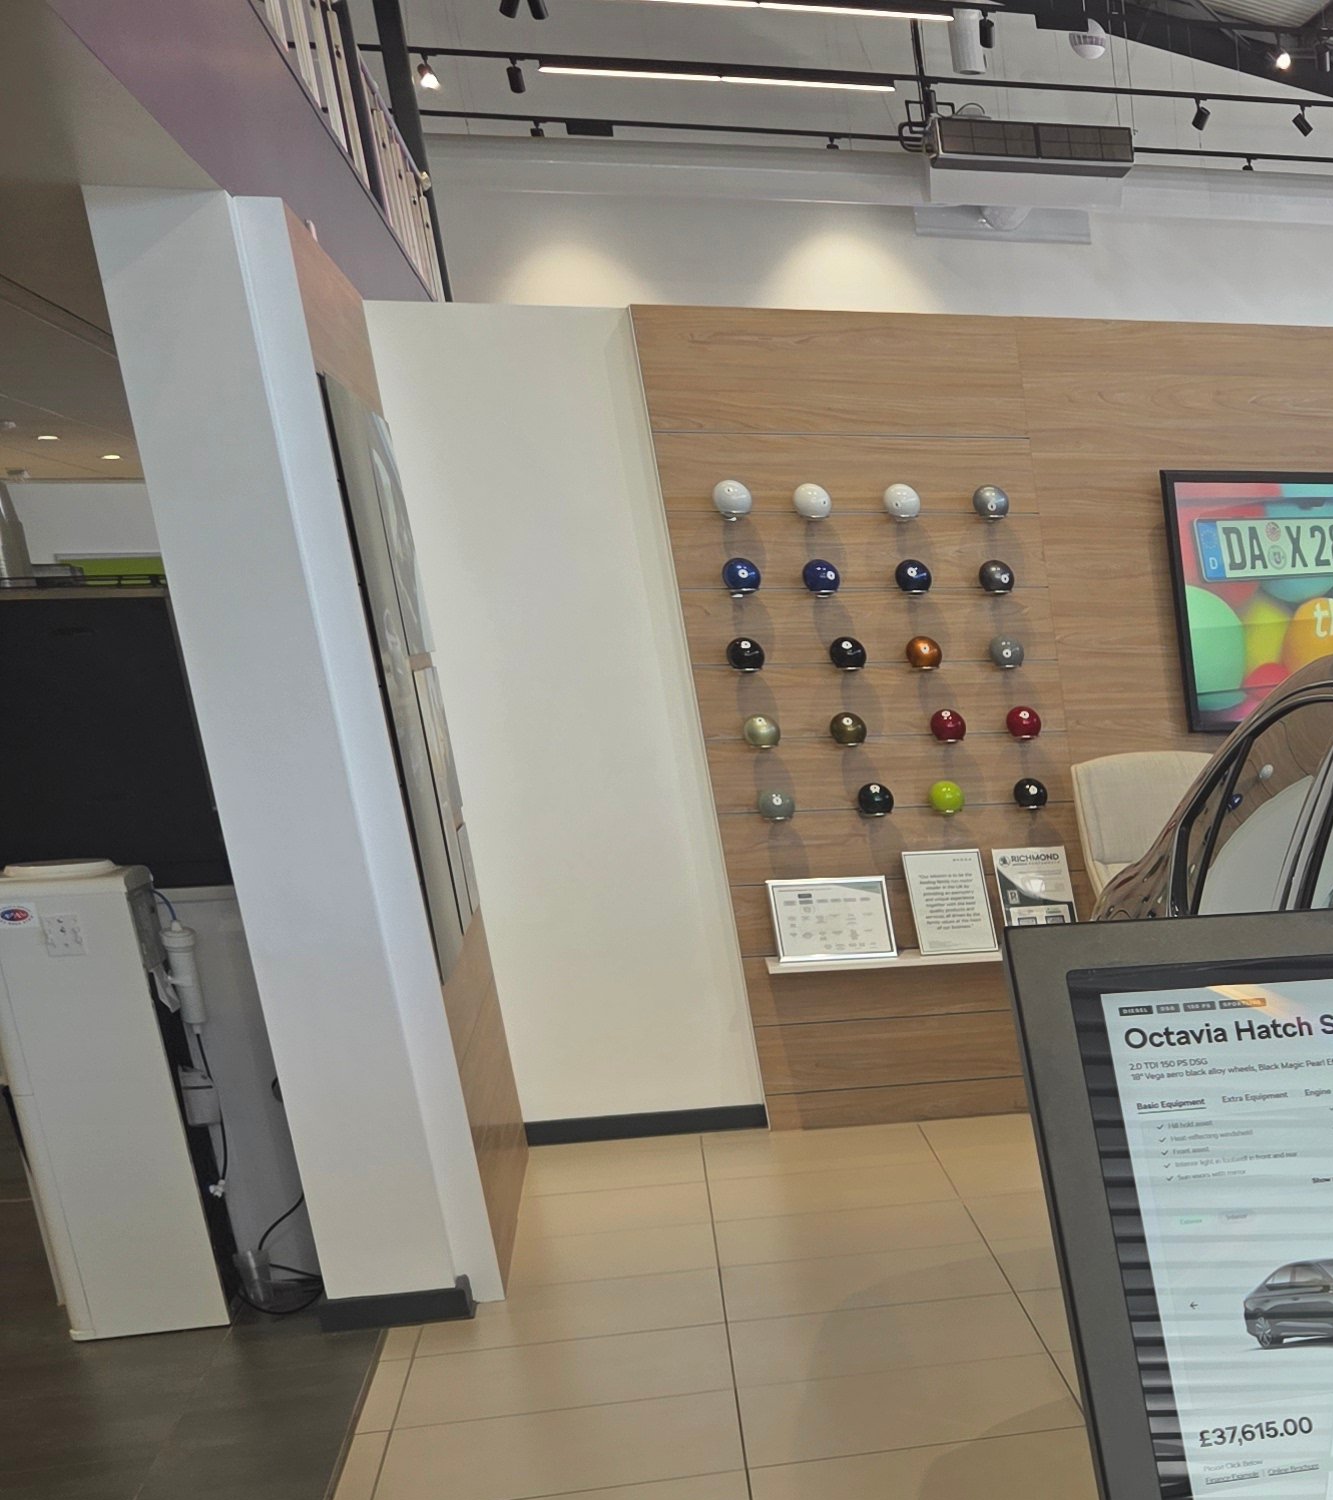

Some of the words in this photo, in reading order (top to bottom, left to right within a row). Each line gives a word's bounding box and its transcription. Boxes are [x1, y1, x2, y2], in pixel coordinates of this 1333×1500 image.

[1222, 526, 1268, 571] DA
[1209, 557, 1219, 570] D
[1010, 853, 1060, 863] RICHMOND
[1124, 1022, 1228, 1049] Octavia
[1233, 1016, 1313, 1042] Hatch
[1128, 1062, 1143, 1071] 2.0
[1143, 1061, 1159, 1070] TDI
[1160, 1059, 1175, 1068] 150
[1176, 1058, 1188, 1067] PS
[1188, 1057, 1208, 1066] DSG
[1144, 1070, 1165, 1081] Vega
[1184, 1067, 1206, 1077] black
[1206, 1066, 1227, 1076] alloy
[1227, 1063, 1257, 1075] wheels,
[1257, 1061, 1280, 1071] Black
[1280, 1059, 1305, 1071] Magic
[1305, 1058, 1325, 1067] Pearl
[1221, 1094, 1244, 1103] Extra
[1243, 1090, 1289, 1103] Equipment
[1303, 1086, 1332, 1097] Engine
[1135, 1100, 1160, 1110] Basic
[1160, 1097, 1206, 1110] Equipment
[1311, 1175, 1331, 1184] Show
[1198, 1416, 1313, 1448] £37,615.00
